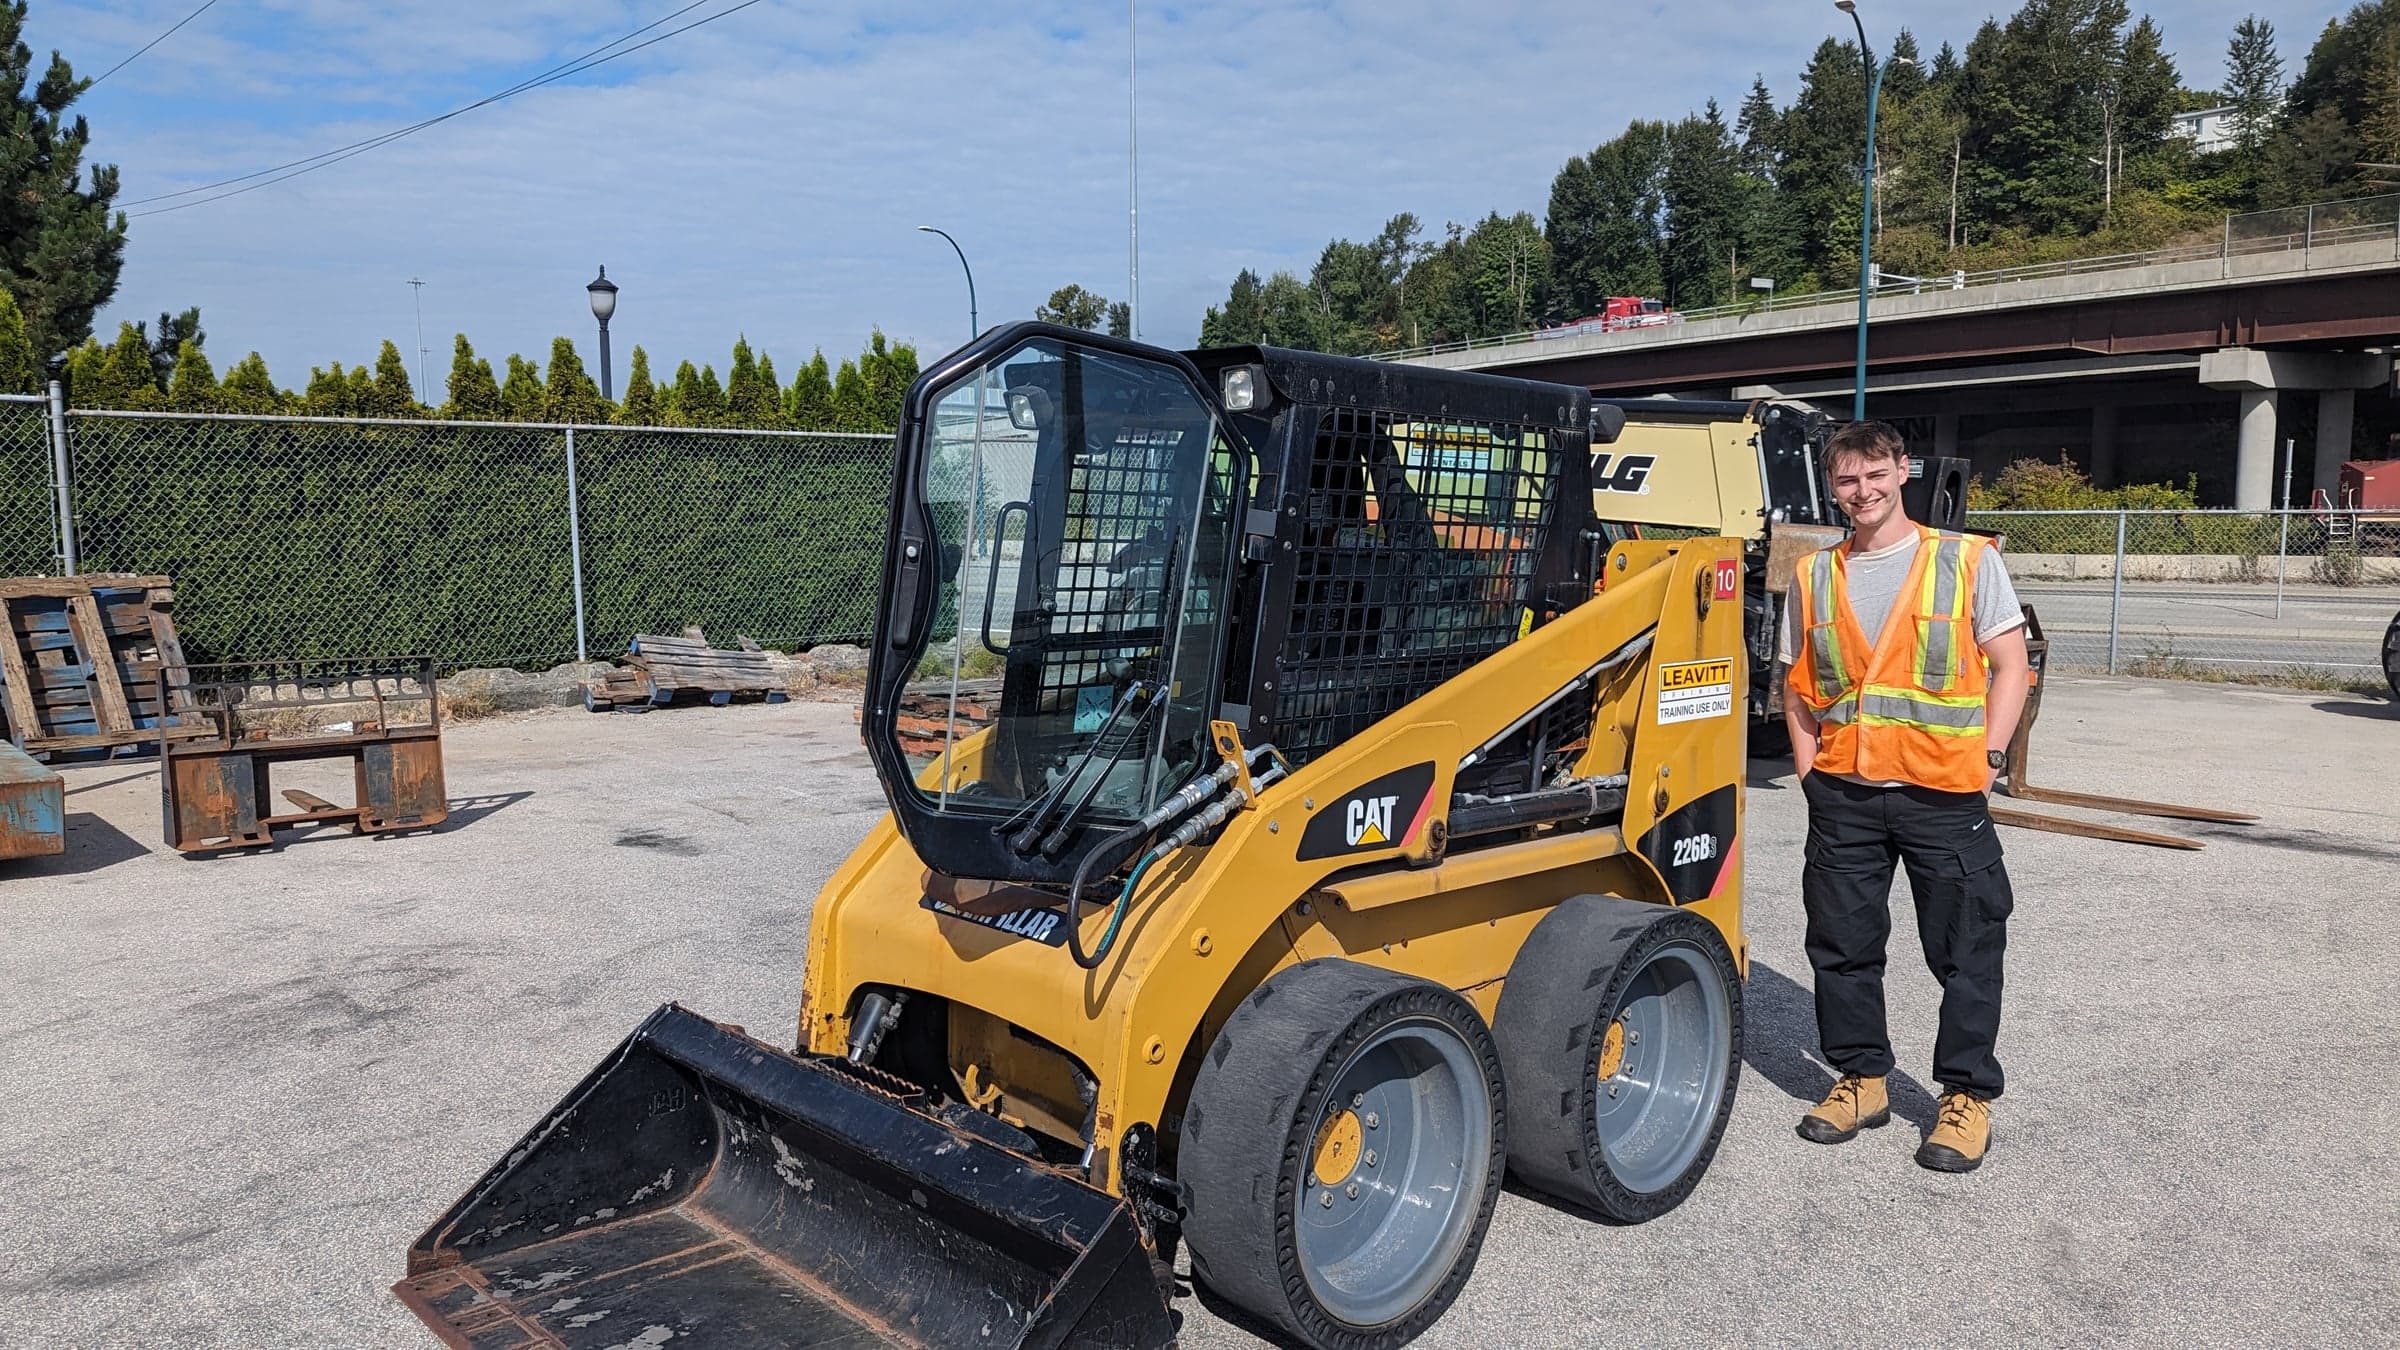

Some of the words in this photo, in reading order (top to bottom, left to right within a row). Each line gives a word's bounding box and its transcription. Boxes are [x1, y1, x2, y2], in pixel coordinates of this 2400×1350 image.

[1591, 454, 1657, 493] LG
[1717, 568, 1735, 592] 10
[1663, 664, 1729, 687] LEAVITT
[1660, 704, 1694, 719] TRAINING
[1696, 702, 1710, 714] USE
[1711, 699, 1730, 712] ONLY
[1346, 795, 1397, 846] CAT
